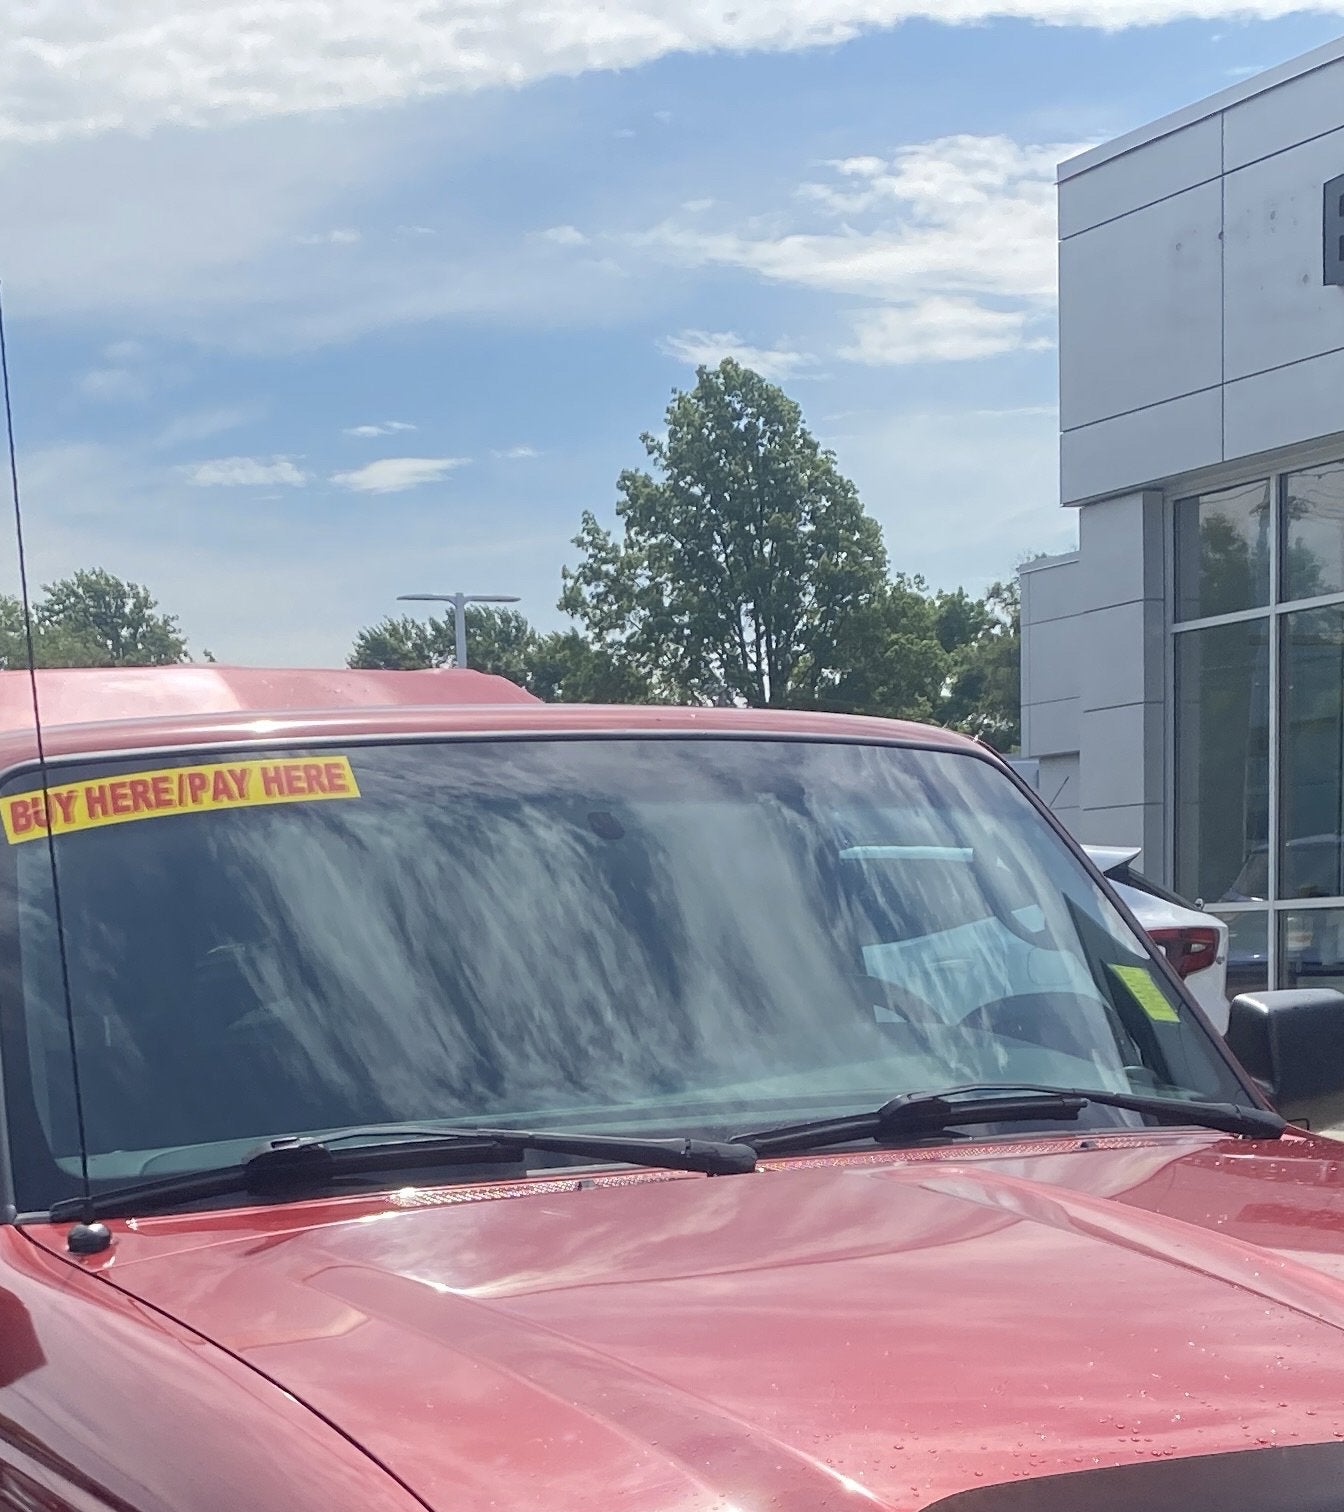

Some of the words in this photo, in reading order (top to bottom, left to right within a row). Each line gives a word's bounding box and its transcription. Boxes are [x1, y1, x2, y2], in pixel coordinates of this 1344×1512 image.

[10, 790, 77, 834] BUY
[86, 767, 252, 819] HERE/PAY
[261, 762, 351, 796] HERE
